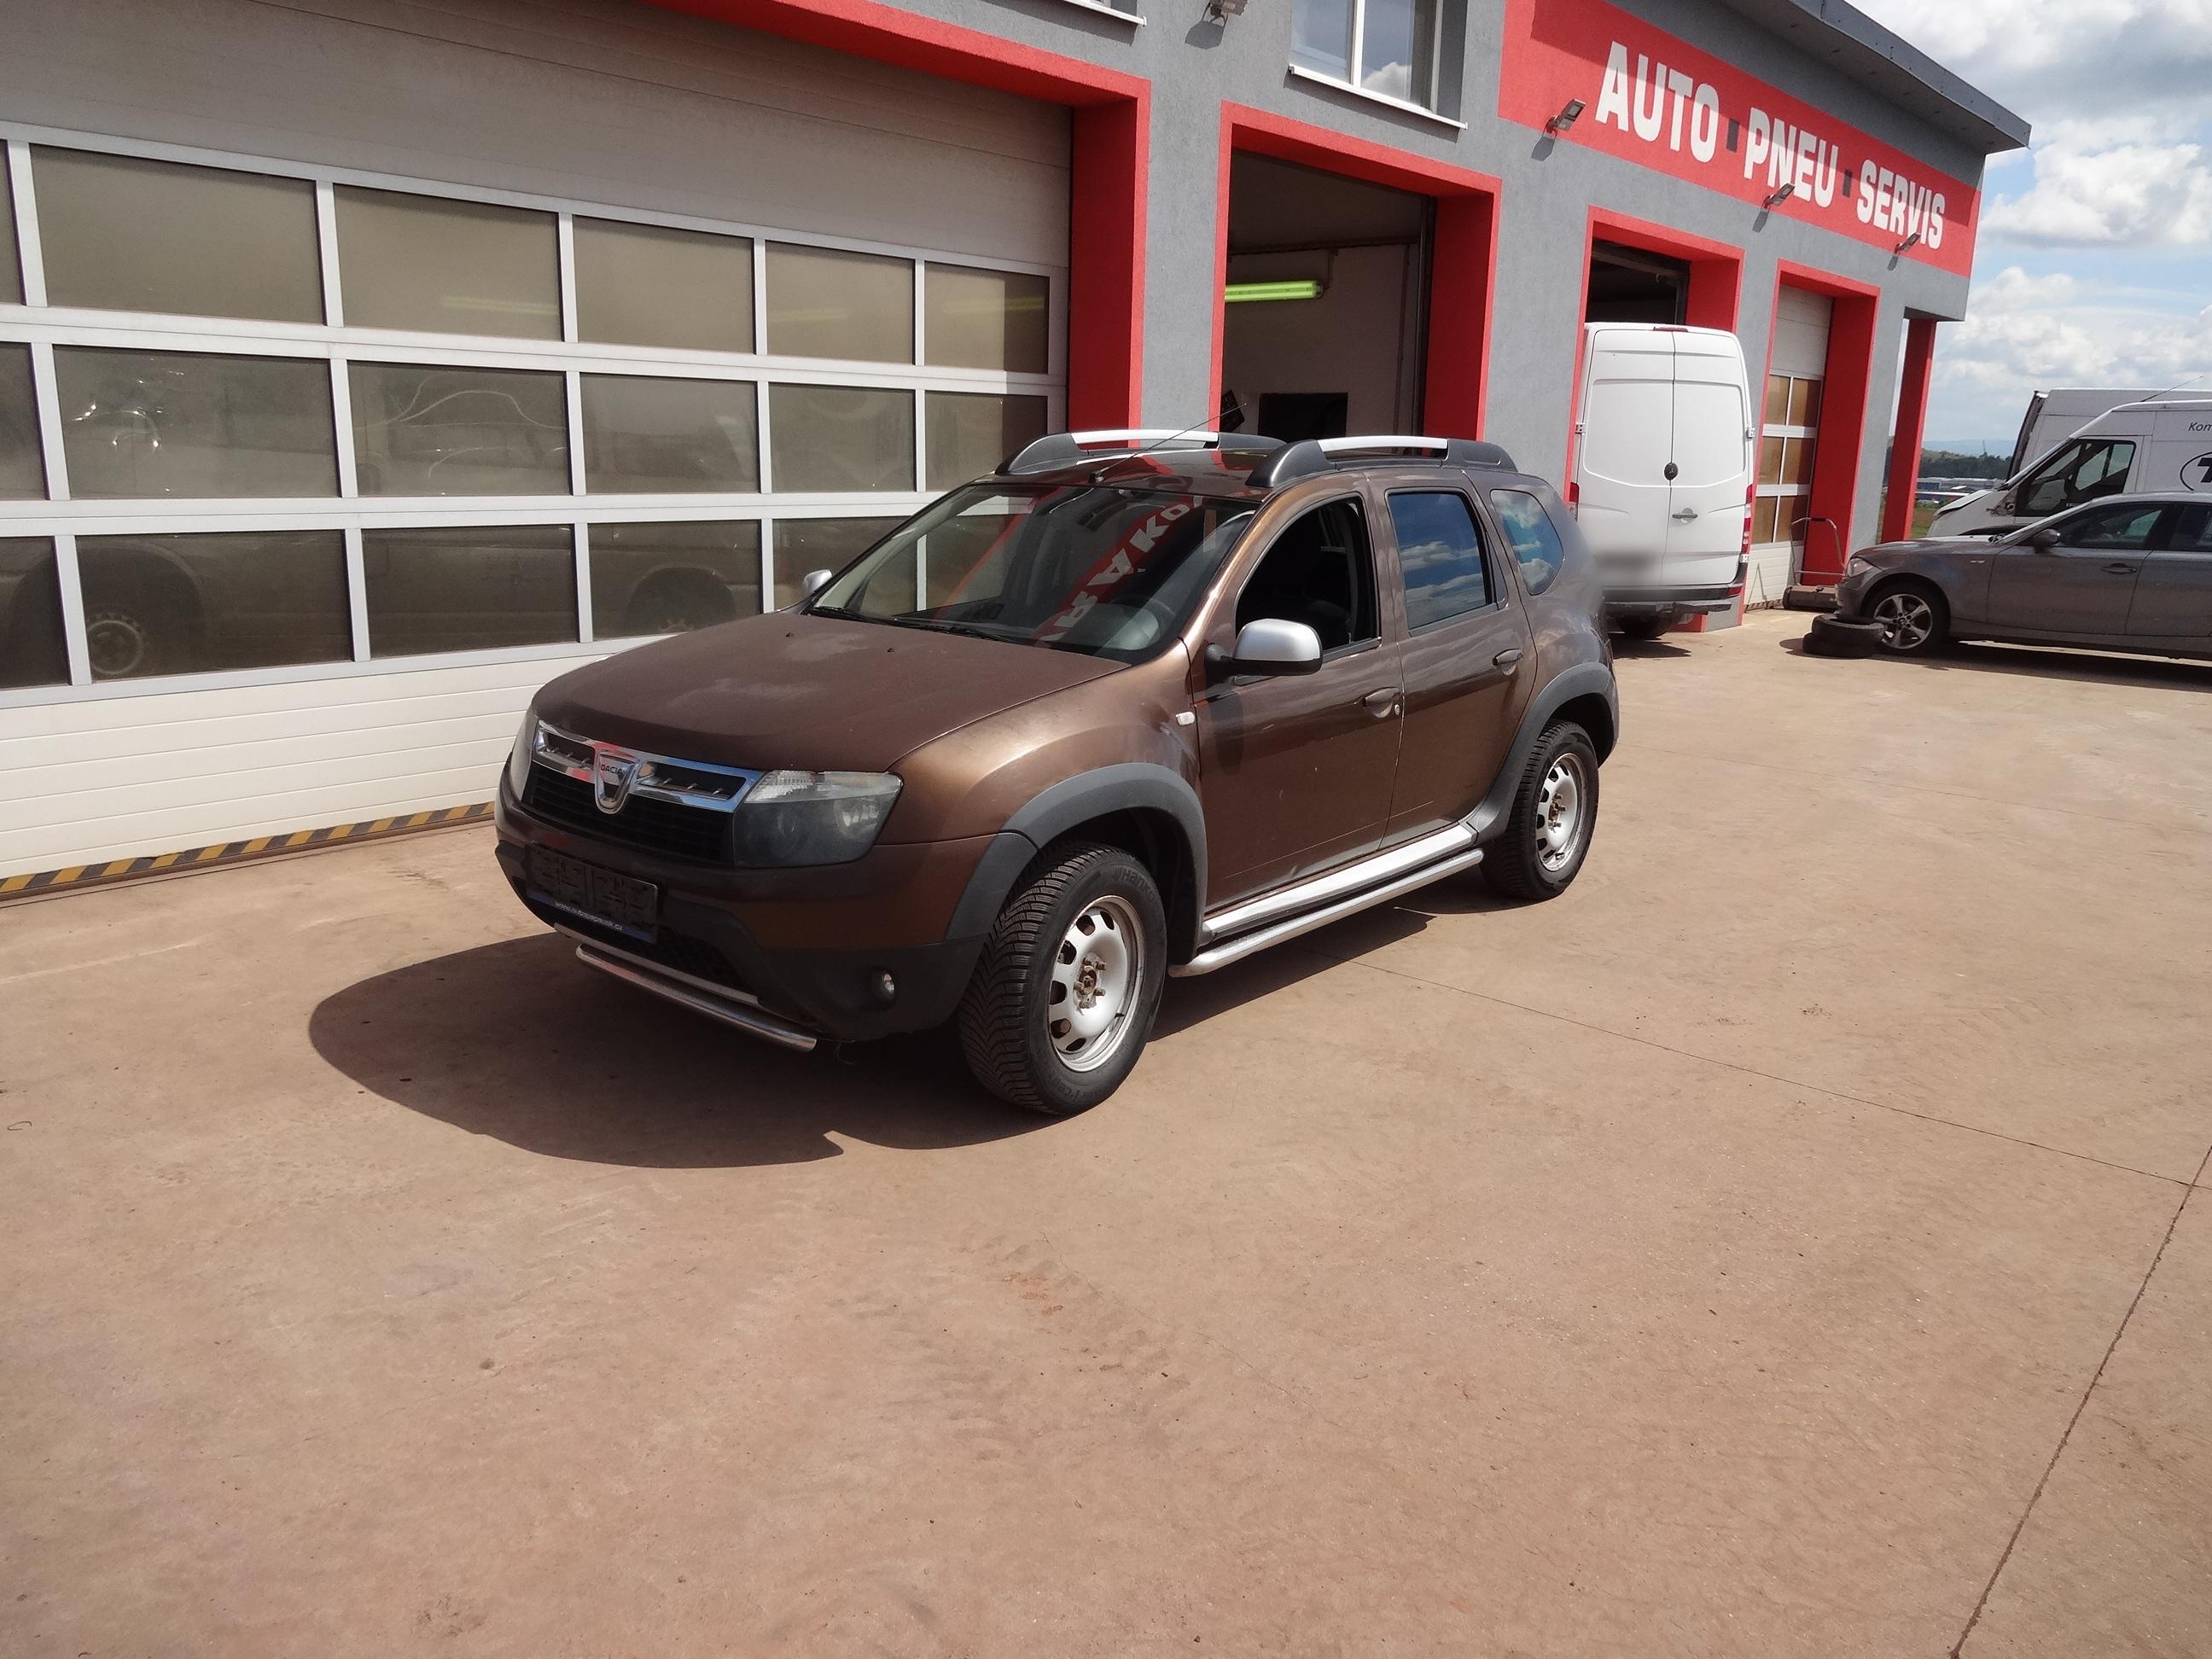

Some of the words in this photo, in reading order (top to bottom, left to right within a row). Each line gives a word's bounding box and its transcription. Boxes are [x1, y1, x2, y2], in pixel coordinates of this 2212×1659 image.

[1594, 40, 1720, 163] AUTO
[1743, 106, 1840, 209] PNEU
[1855, 158, 1947, 251] SERVIS
[600, 764, 624, 777] DACIA
